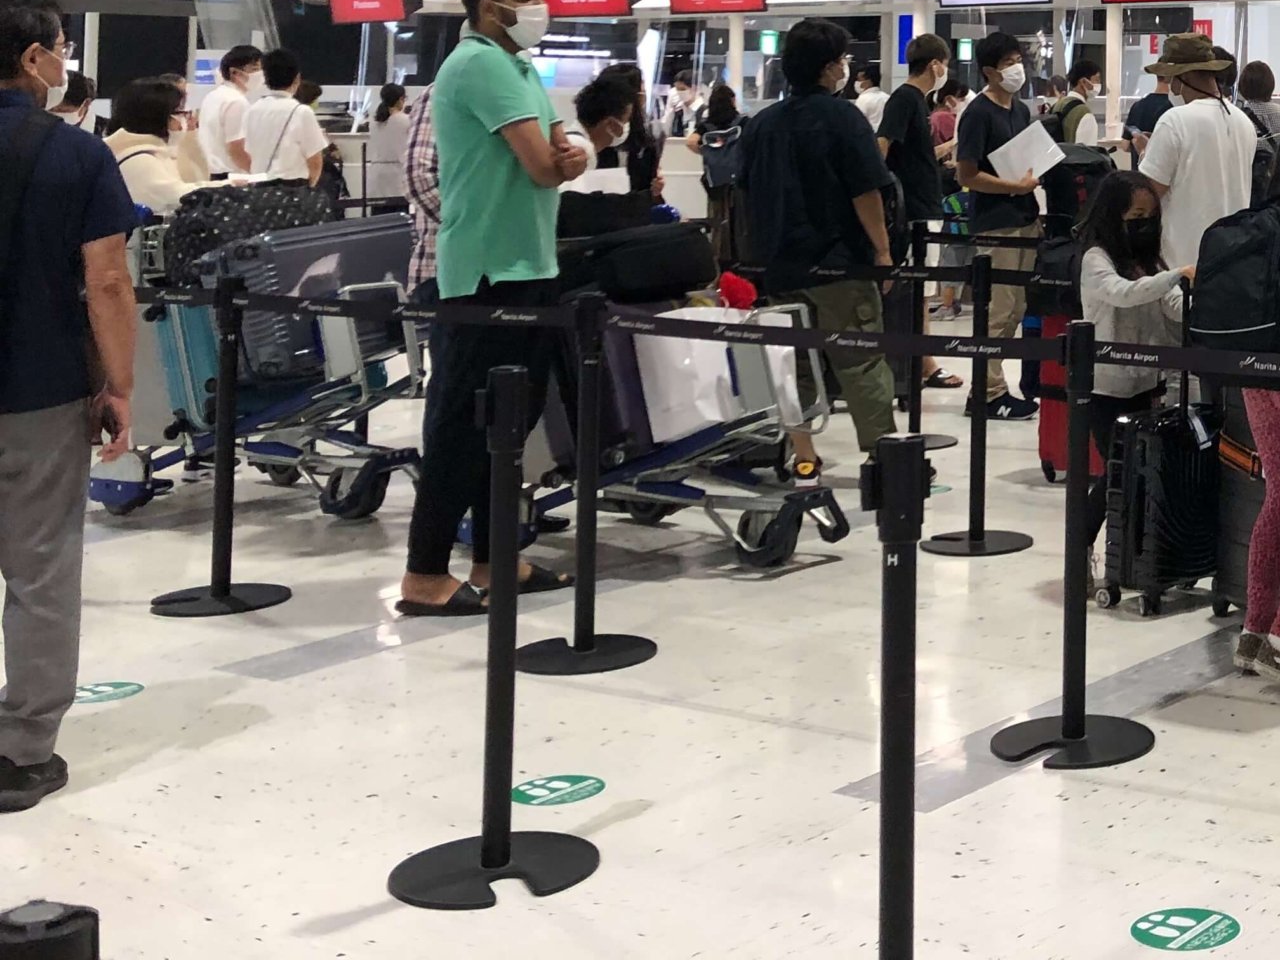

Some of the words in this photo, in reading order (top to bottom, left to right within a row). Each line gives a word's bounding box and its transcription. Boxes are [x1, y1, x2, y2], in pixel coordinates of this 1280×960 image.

[837, 338, 855, 347] Narita
[856, 339, 878, 348] Airport
[957, 344, 977, 353] Narita
[978, 344, 1002, 355] Airport
[1110, 350, 1132, 361] Narita
[1133, 351, 1159, 363] Airport
[1254, 360, 1277, 371] Narita
[886, 553, 899, 567] H
